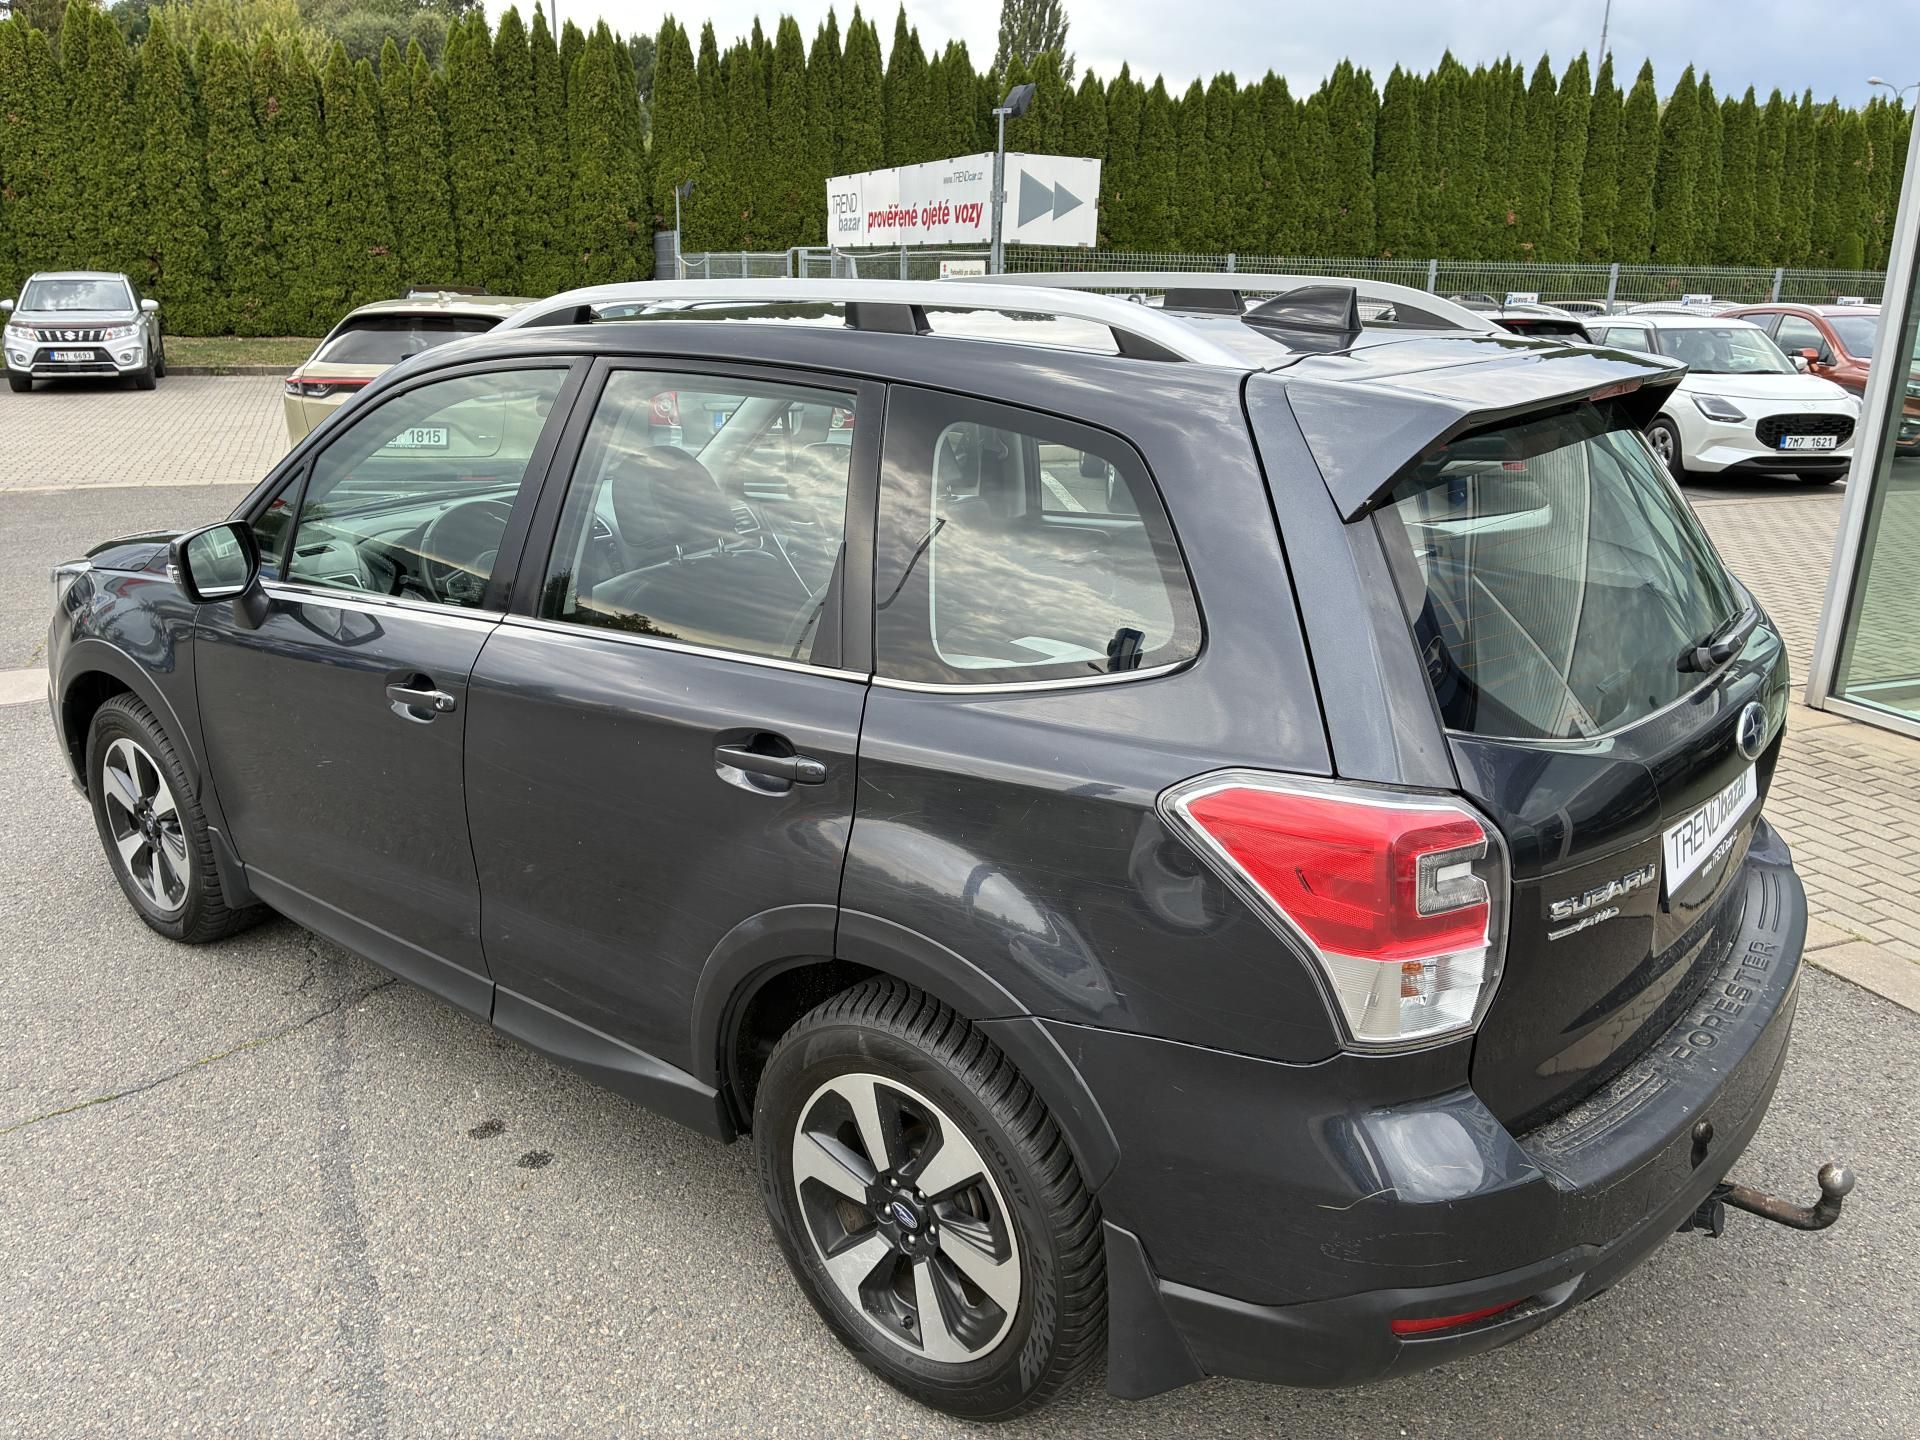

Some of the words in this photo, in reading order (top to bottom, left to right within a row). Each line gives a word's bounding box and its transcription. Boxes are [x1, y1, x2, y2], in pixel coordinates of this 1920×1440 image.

[832, 192, 858, 214] TREND
[838, 213, 861, 232] bazar
[867, 202, 918, 233] prověřené
[921, 198, 950, 231] ojeté
[954, 202, 983, 229] vozy
[408, 430, 441, 443] 1815
[1788, 437, 1805, 447] 7M7
[1811, 437, 1832, 447] 1621
[1547, 863, 1656, 922] SUBARU
[1668, 939, 1779, 1068] FORESTER
